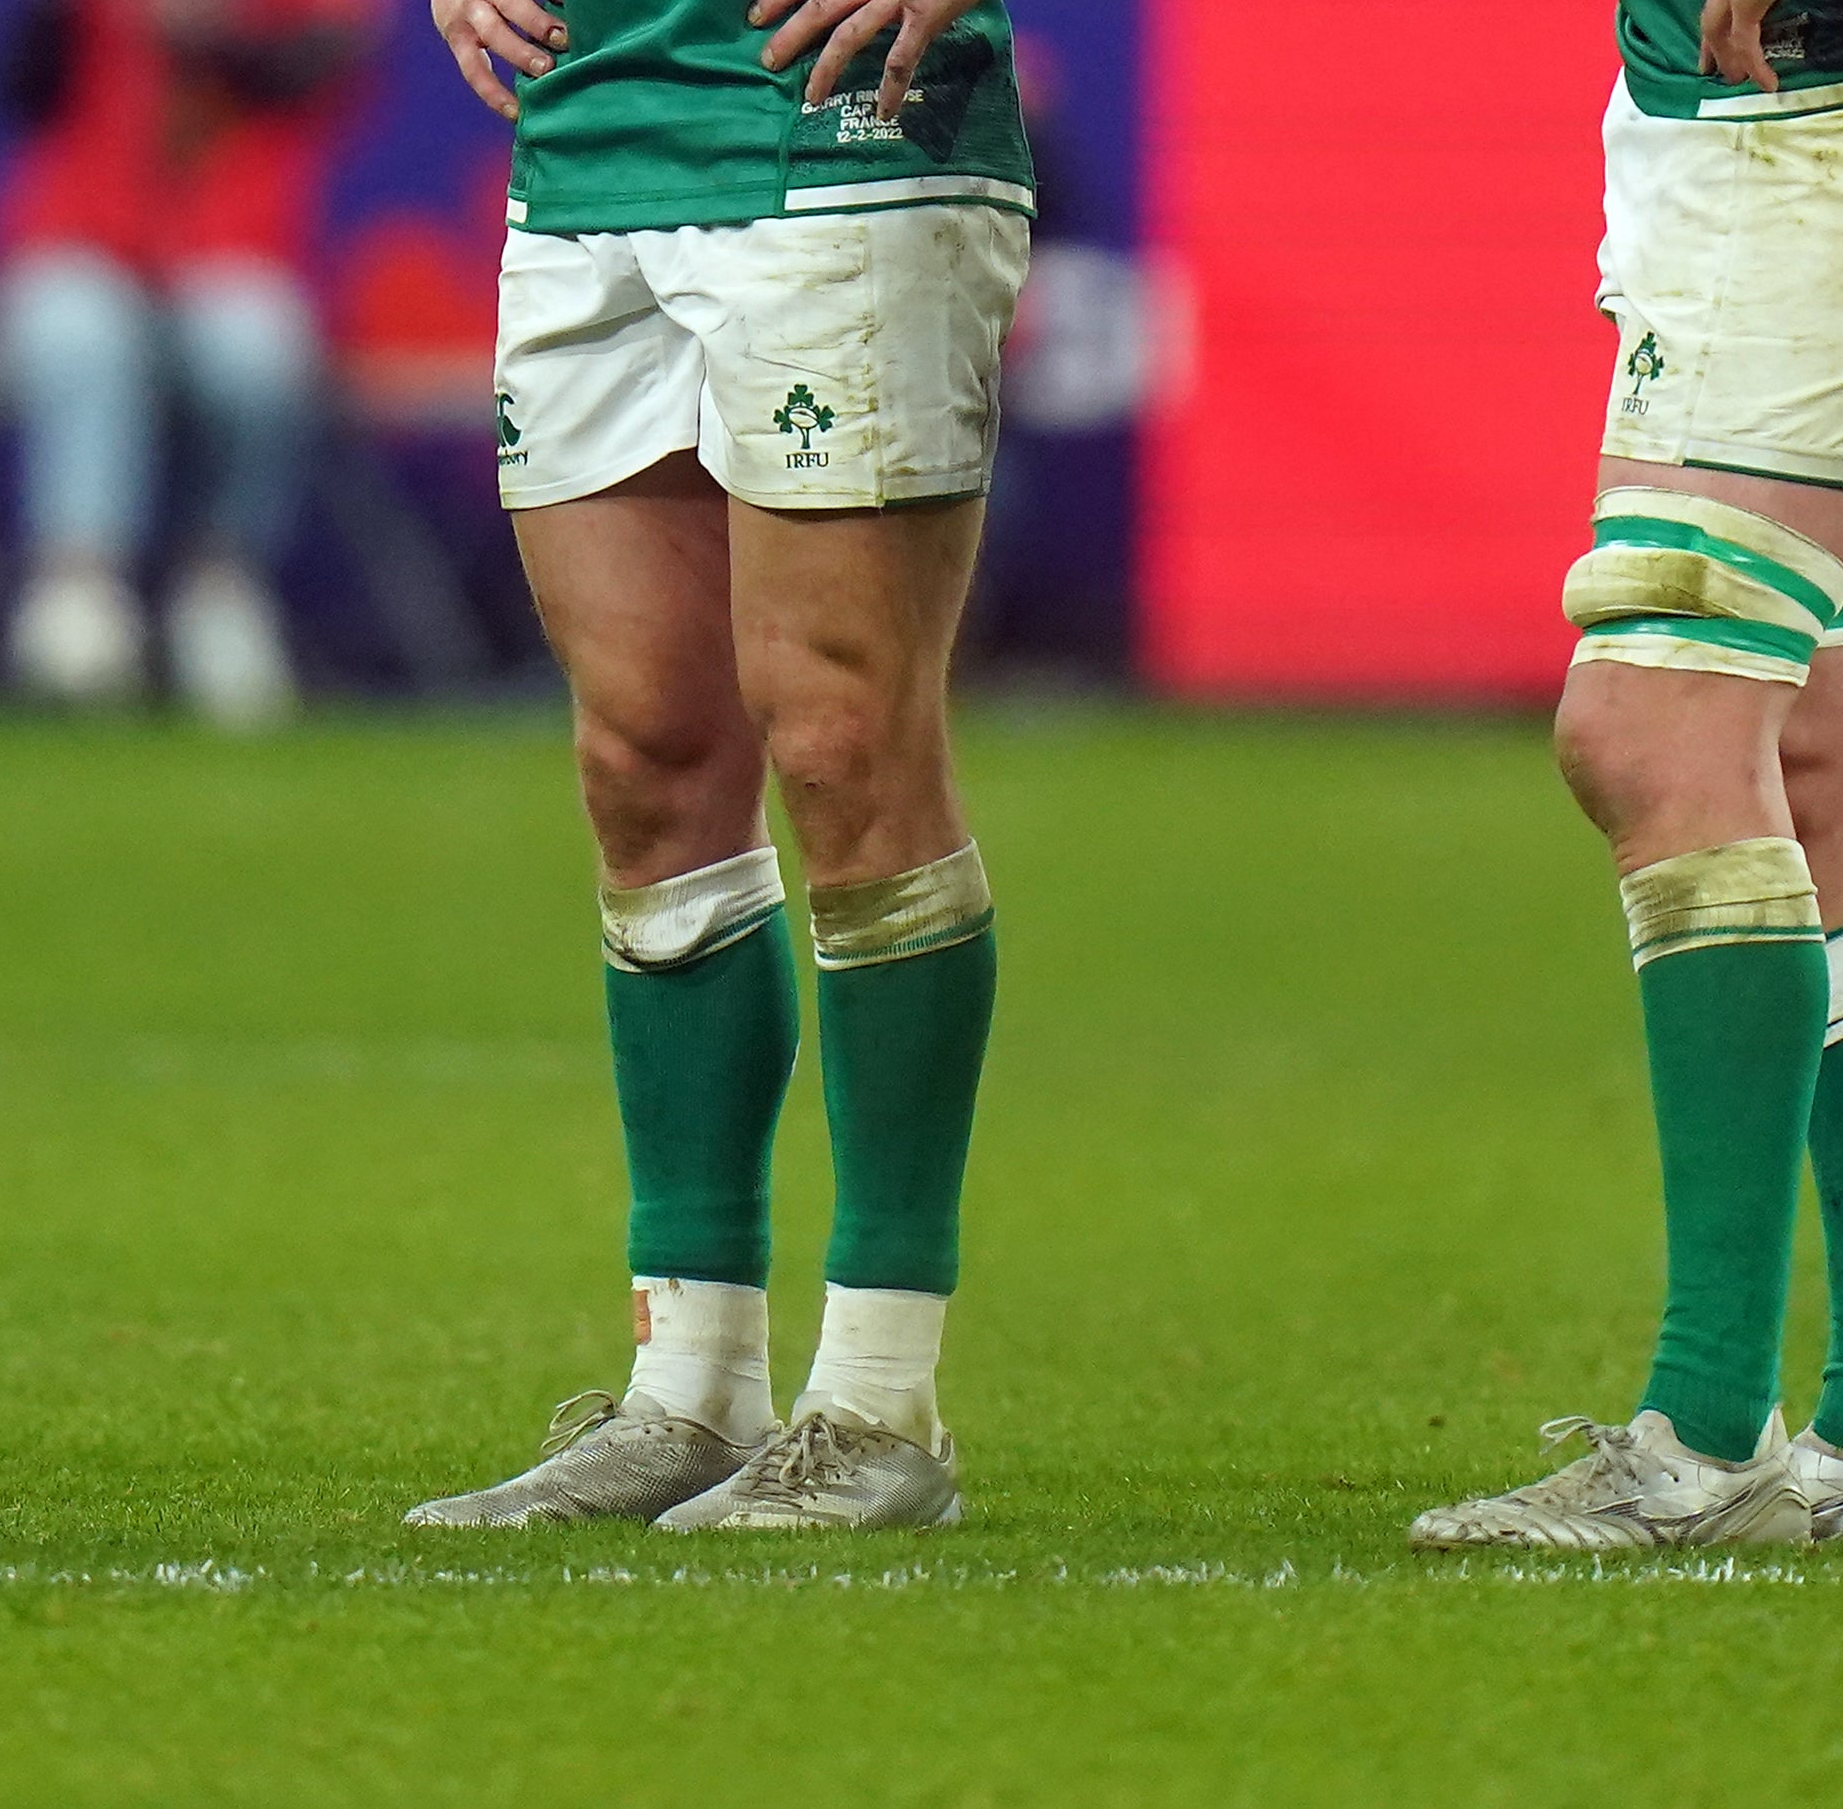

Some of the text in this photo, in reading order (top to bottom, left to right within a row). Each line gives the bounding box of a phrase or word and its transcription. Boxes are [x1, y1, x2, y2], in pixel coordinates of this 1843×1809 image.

[855, 89, 925, 104] RINSE
[840, 103, 873, 118] CAP
[836, 127, 904, 143] 12-2-2022
[1621, 396, 1650, 415] IRFU
[785, 452, 830, 469] IRFU
